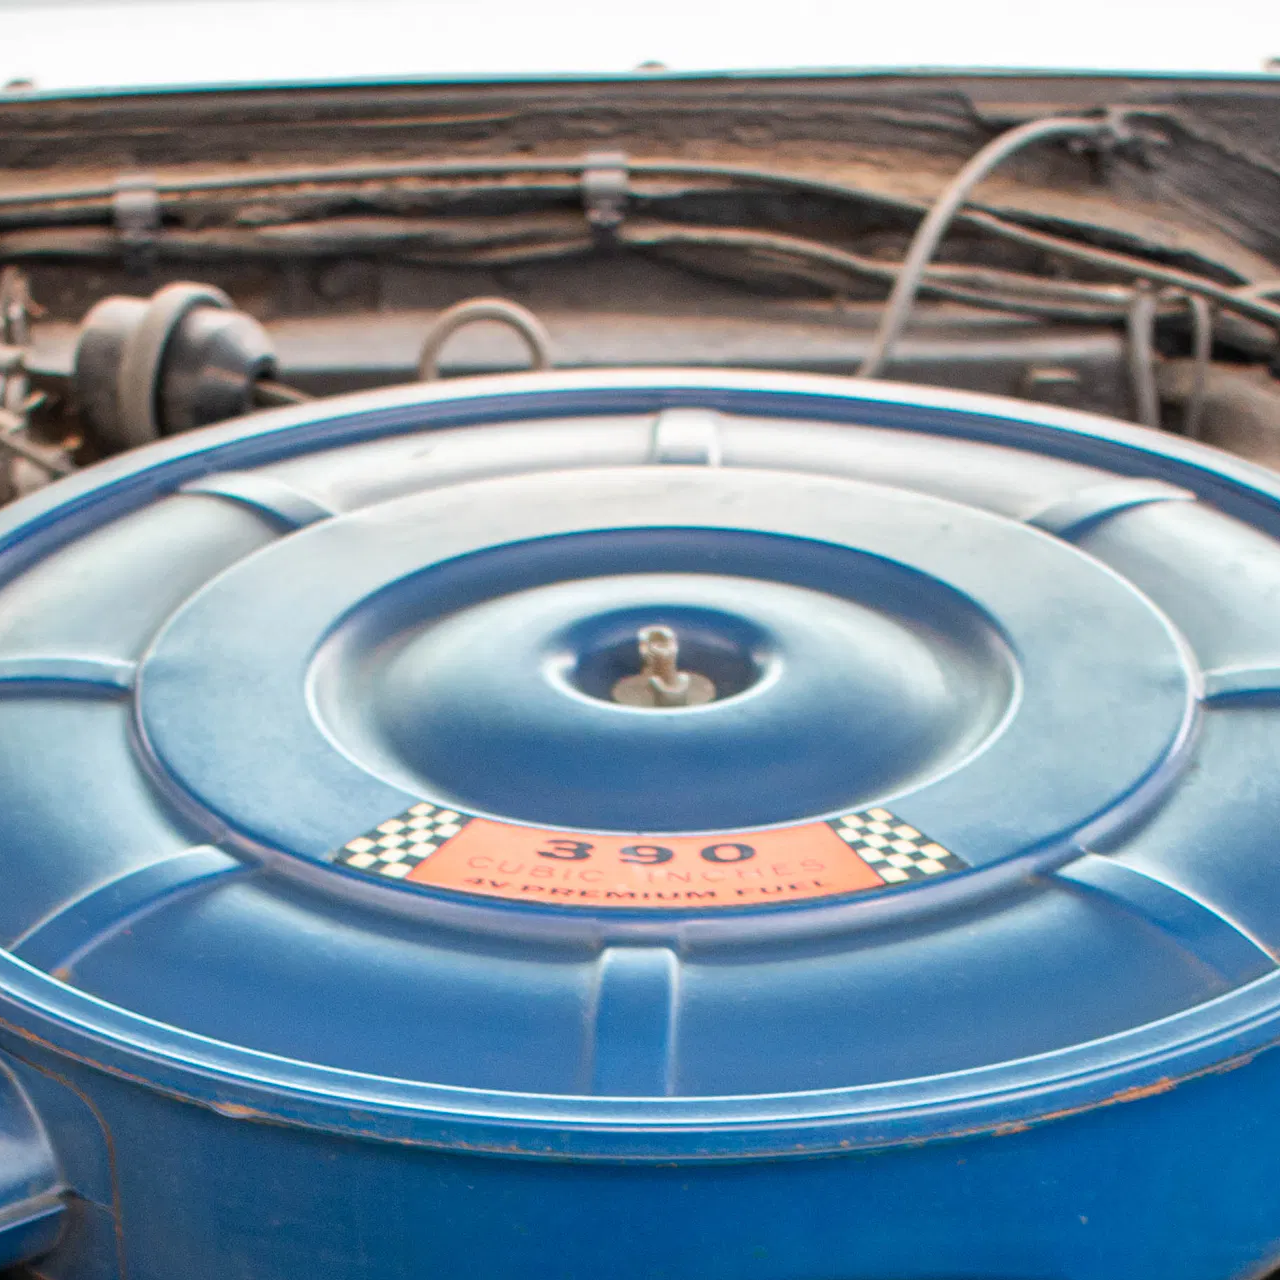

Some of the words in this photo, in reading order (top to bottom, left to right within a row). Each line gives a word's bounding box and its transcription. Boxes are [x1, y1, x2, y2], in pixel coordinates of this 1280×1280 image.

[535, 839, 757, 865] 390
[466, 854, 606, 884] CUBIC
[649, 856, 827, 885] INCHES
[509, 883, 718, 901] PREMIUM
[735, 878, 826, 898] FUEL
